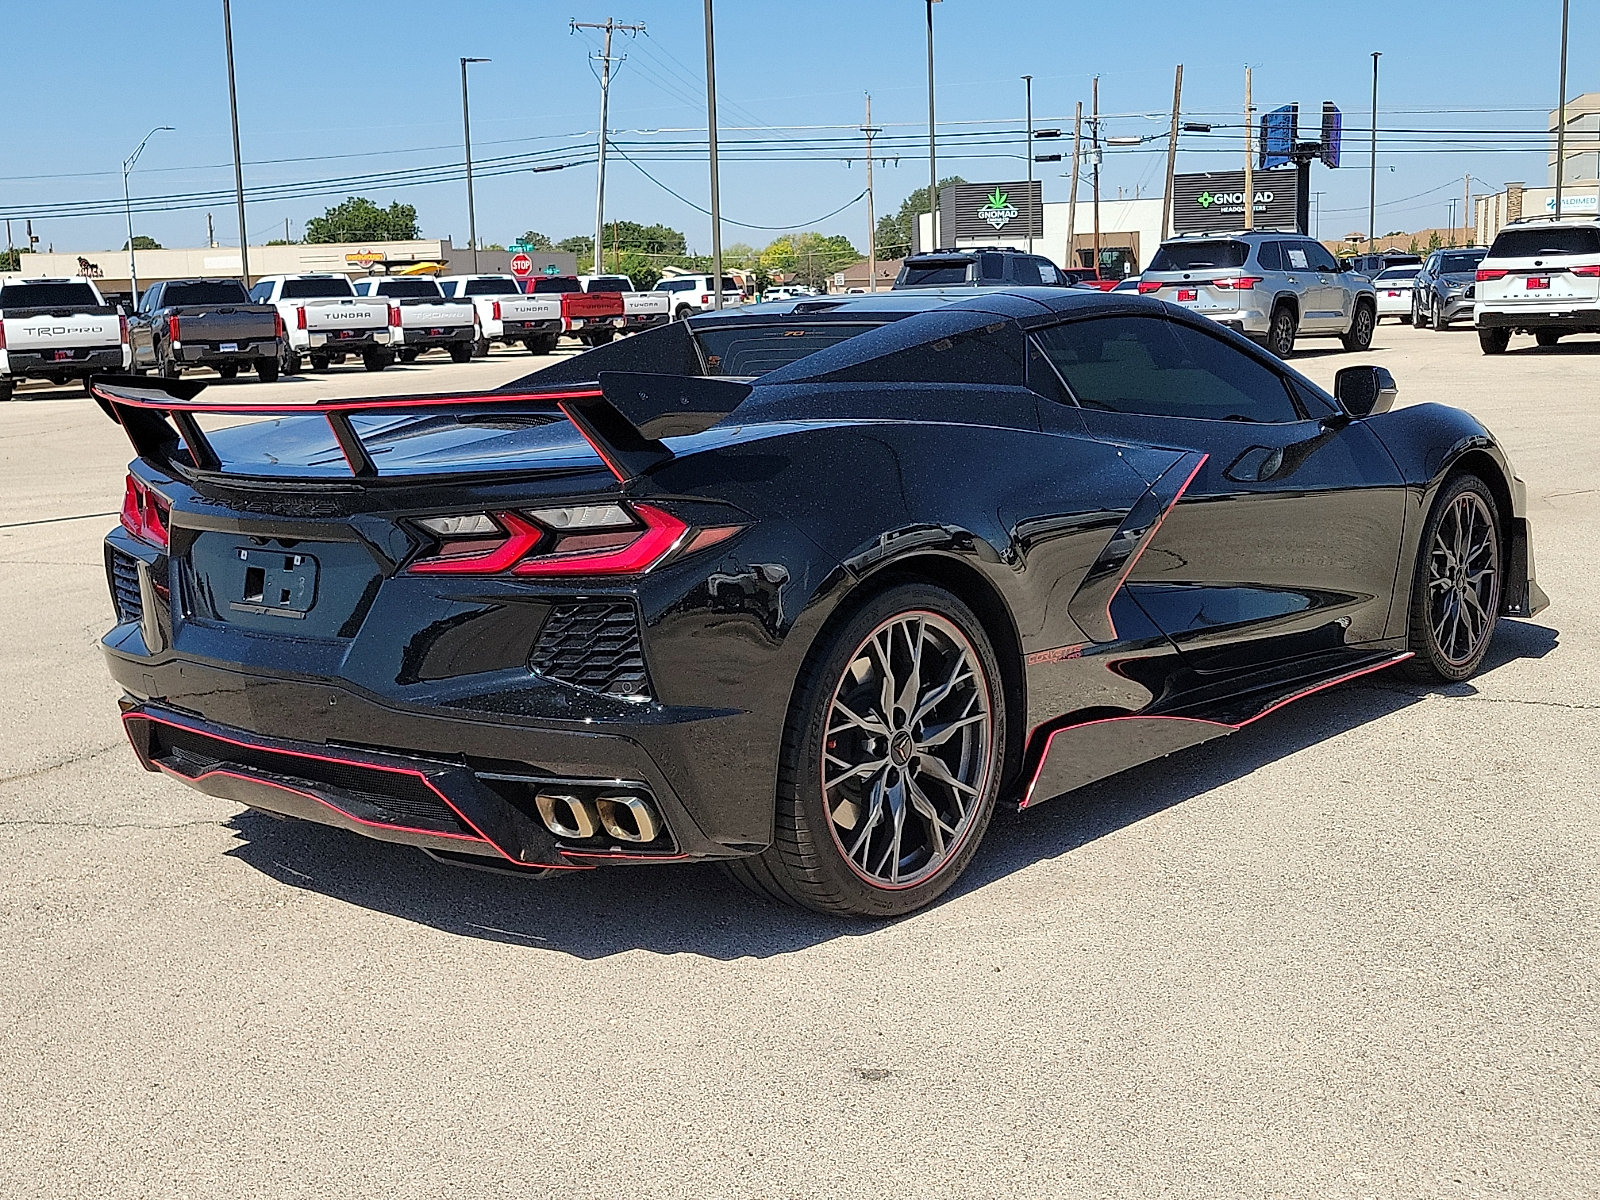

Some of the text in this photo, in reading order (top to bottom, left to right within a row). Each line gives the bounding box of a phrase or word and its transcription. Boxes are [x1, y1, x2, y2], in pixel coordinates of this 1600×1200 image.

[978, 210, 1018, 219] GNOMAD
[512, 261, 530, 269] STOP
[23, 327, 65, 336] TRD
